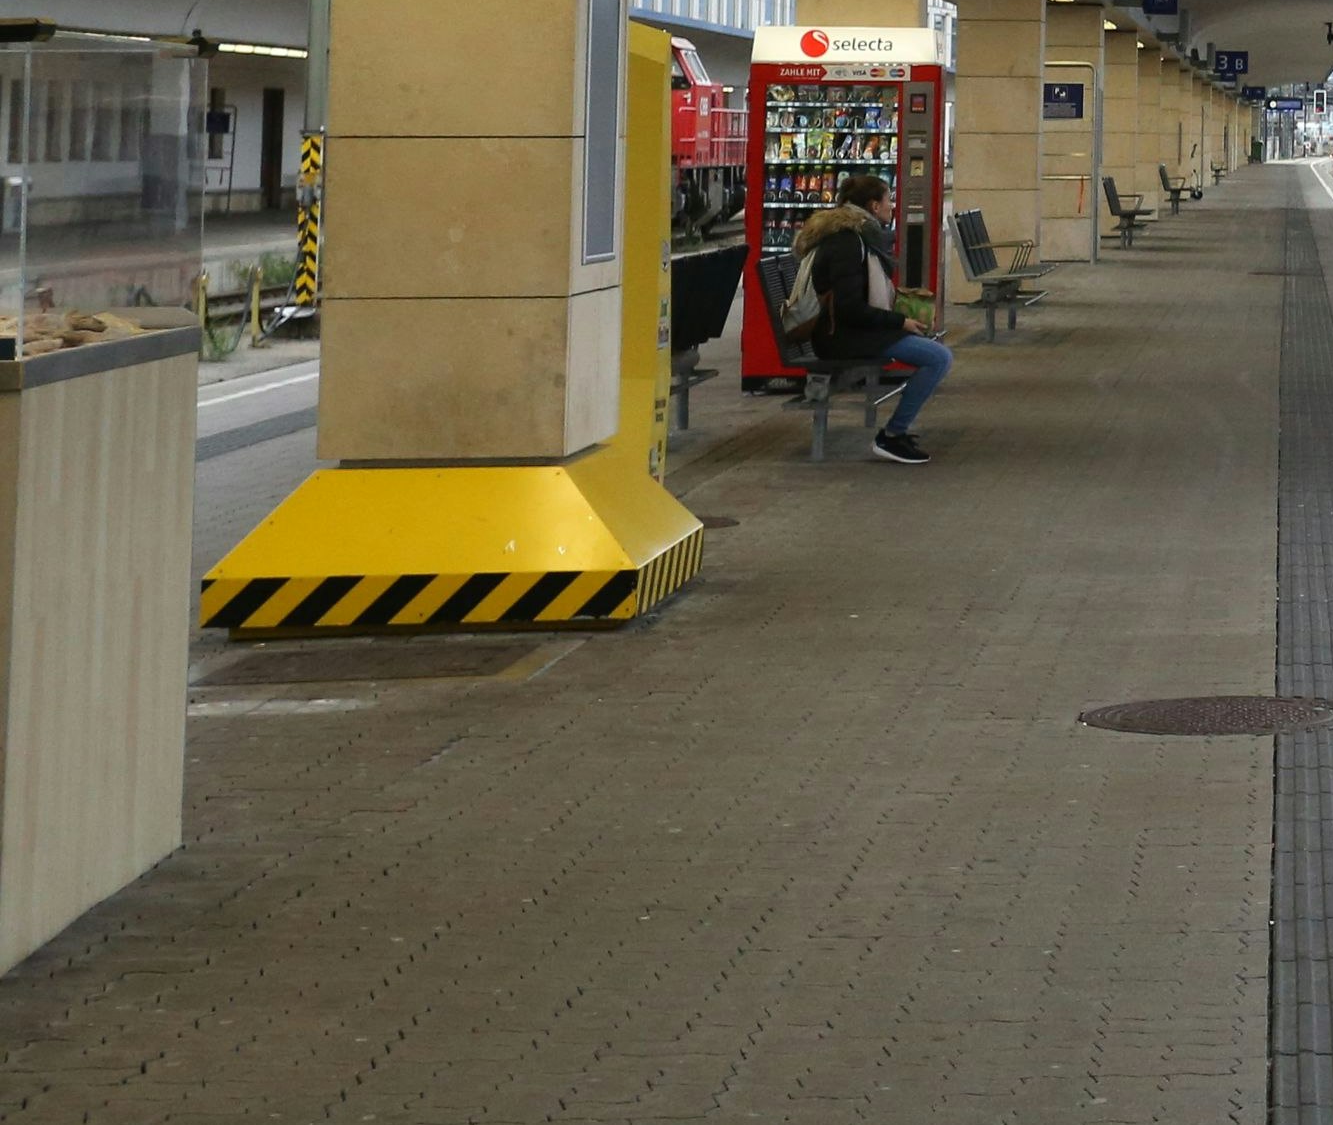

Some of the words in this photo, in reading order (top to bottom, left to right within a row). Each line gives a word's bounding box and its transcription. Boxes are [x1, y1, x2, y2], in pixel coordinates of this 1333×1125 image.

[832, 37, 893, 52] selecta
[1218, 54, 1228, 71] 3
[1235, 58, 1244, 71] B
[779, 67, 805, 77] ZAHLE
[806, 67, 821, 77] MIT
